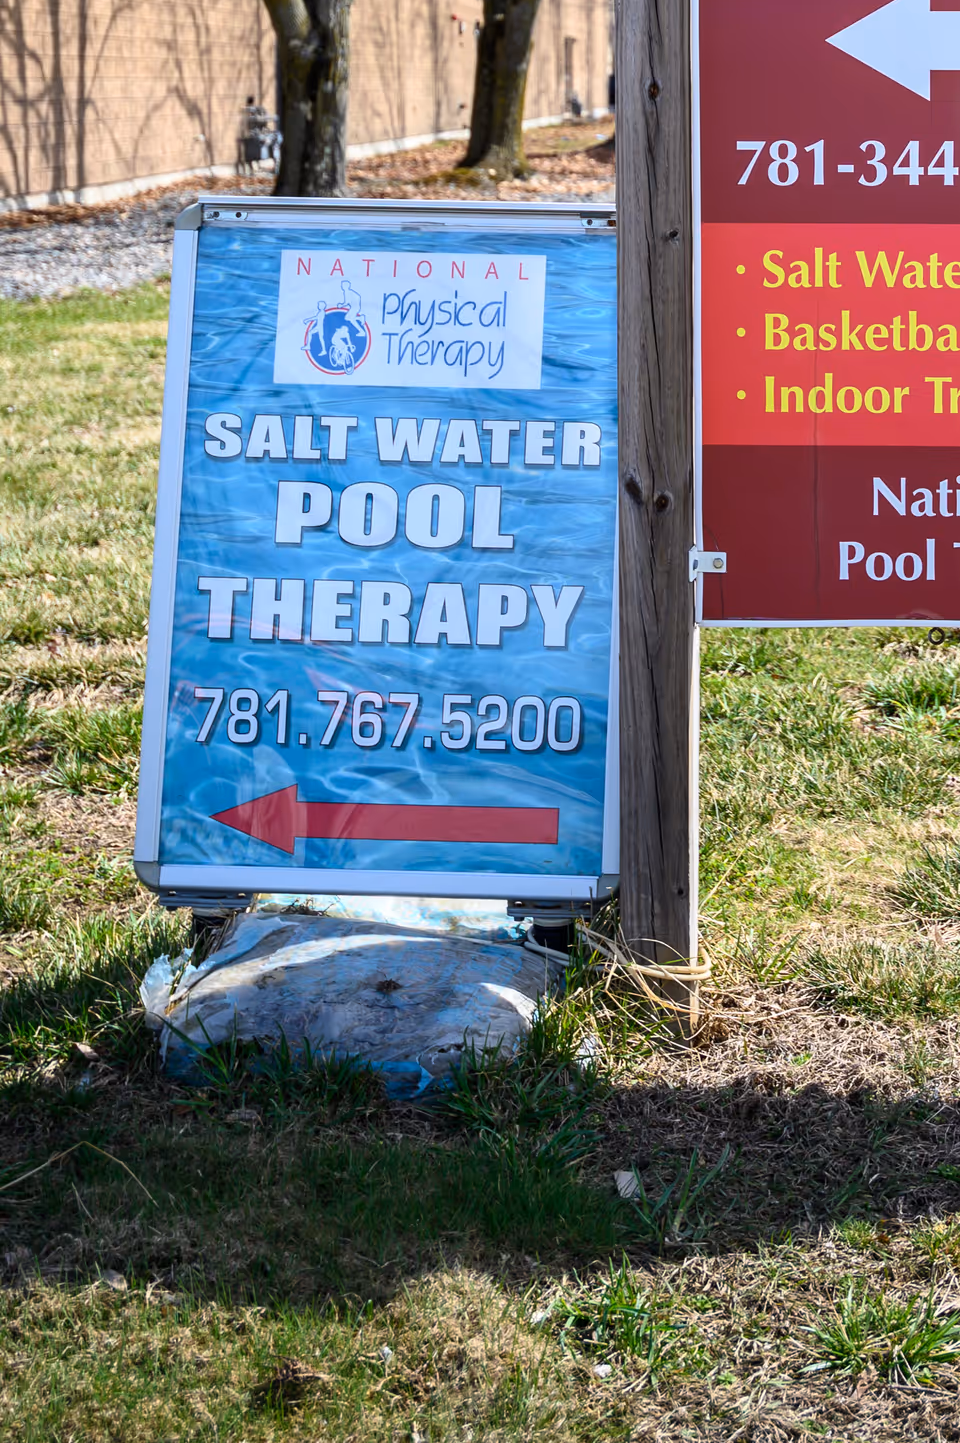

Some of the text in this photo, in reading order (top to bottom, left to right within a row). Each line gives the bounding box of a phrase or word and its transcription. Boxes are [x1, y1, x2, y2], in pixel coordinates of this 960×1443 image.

[296, 257, 530, 280] NATIONAL
[763, 247, 843, 289] Salt
[381, 288, 508, 338] Physical
[381, 328, 506, 379] Therapy
[764, 372, 909, 414] Indoor
[204, 413, 602, 467] SALT WATER
[275, 481, 515, 549] POOL
[839, 538, 936, 582] Pool
[197, 575, 585, 649] THERAPY
[193, 687, 583, 753] 781.767.5200
